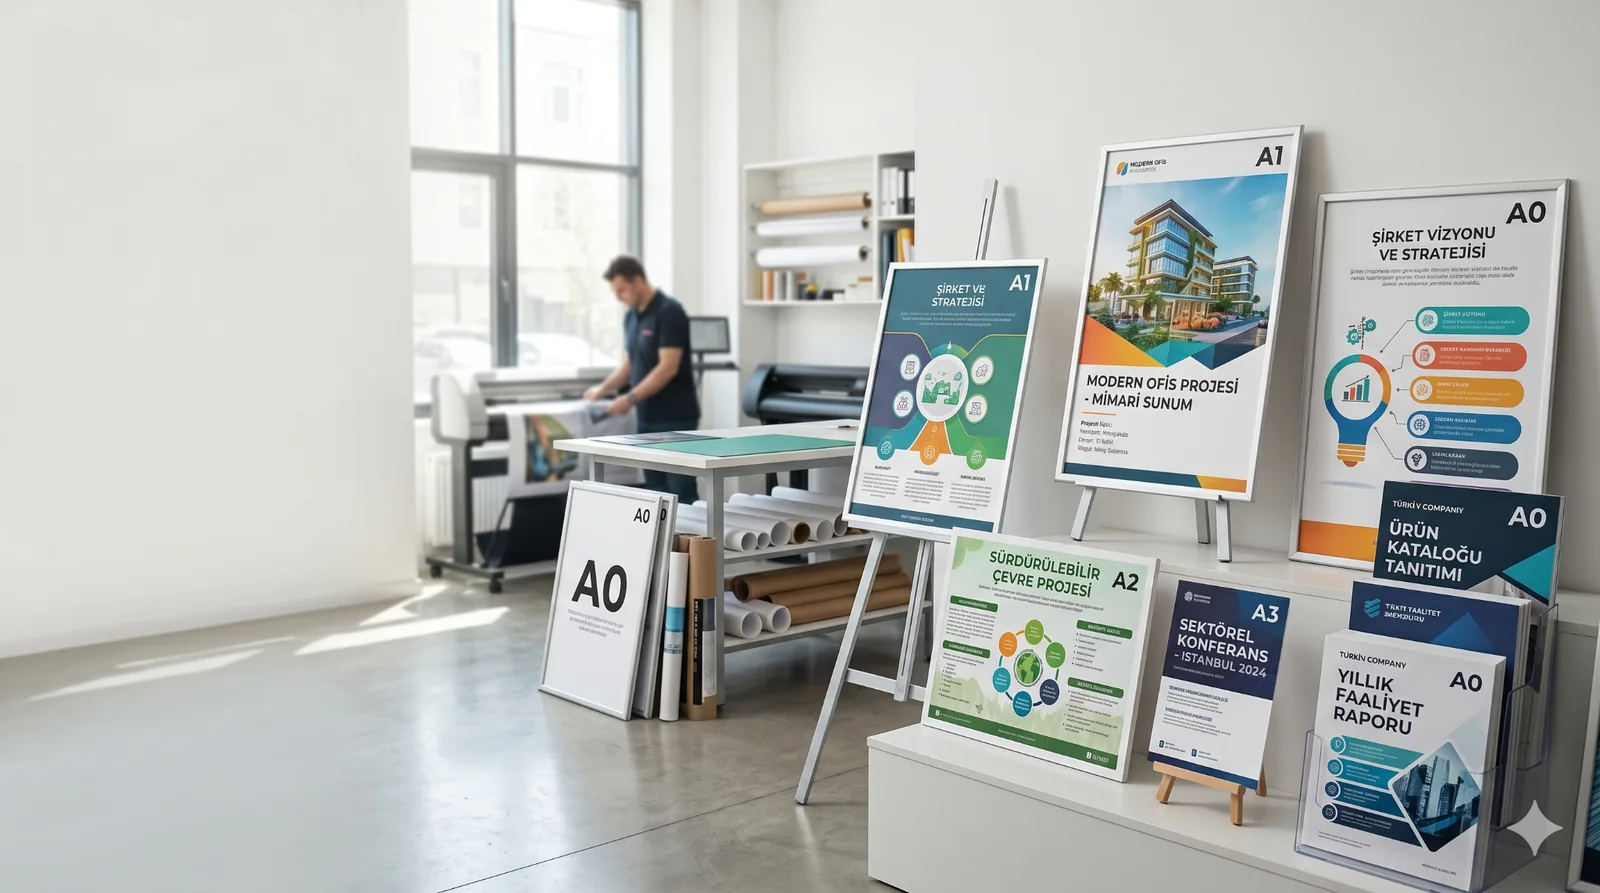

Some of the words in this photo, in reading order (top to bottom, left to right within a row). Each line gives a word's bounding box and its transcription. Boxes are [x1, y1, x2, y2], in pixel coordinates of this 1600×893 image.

[1255, 145, 1283, 167] A1
[1505, 200, 1547, 225] A0
[1372, 228, 1424, 247] ŞİRKET
[1427, 225, 1496, 241] VİZYONU
[1379, 249, 1398, 261] VE
[1401, 243, 1486, 260] STRATEJİSİ
[936, 283, 969, 297] ŞİRKET
[1008, 274, 1031, 292] A1
[931, 295, 985, 307] STRATEJİSİ
[1086, 375, 1143, 389] MODERN
[1146, 375, 1177, 390] OFİS
[1180, 378, 1240, 394] PROJESİ
[1092, 391, 1141, 408] MİMARİ
[1142, 396, 1193, 411] SUNUM
[633, 507, 651, 524] A0
[1507, 506, 1547, 529] A0
[1389, 518, 1439, 541] ÜRÜN
[1387, 540, 1483, 565] KATALOĞU
[989, 550, 1101, 581] SÜRDÜRÜLEBİLİR
[1385, 558, 1463, 582] TANITIMI
[571, 559, 628, 613] A0
[992, 569, 1034, 588] ÇEVRE
[1036, 578, 1092, 598] PROJESİ
[1111, 571, 1139, 592] A2
[1251, 603, 1280, 624] A3
[1179, 618, 1254, 644] SEKTÖREL
[1177, 634, 1269, 663] KONFERANS
[1181, 651, 1236, 672] ISTANBUL
[1238, 663, 1267, 678] 2024
[1367, 656, 1407, 670] COMPANY
[1338, 668, 1394, 693] YILLIK
[1449, 671, 1483, 692] A0
[1335, 687, 1424, 718] FAALİYET
[1333, 705, 1413, 735] RAPORU
